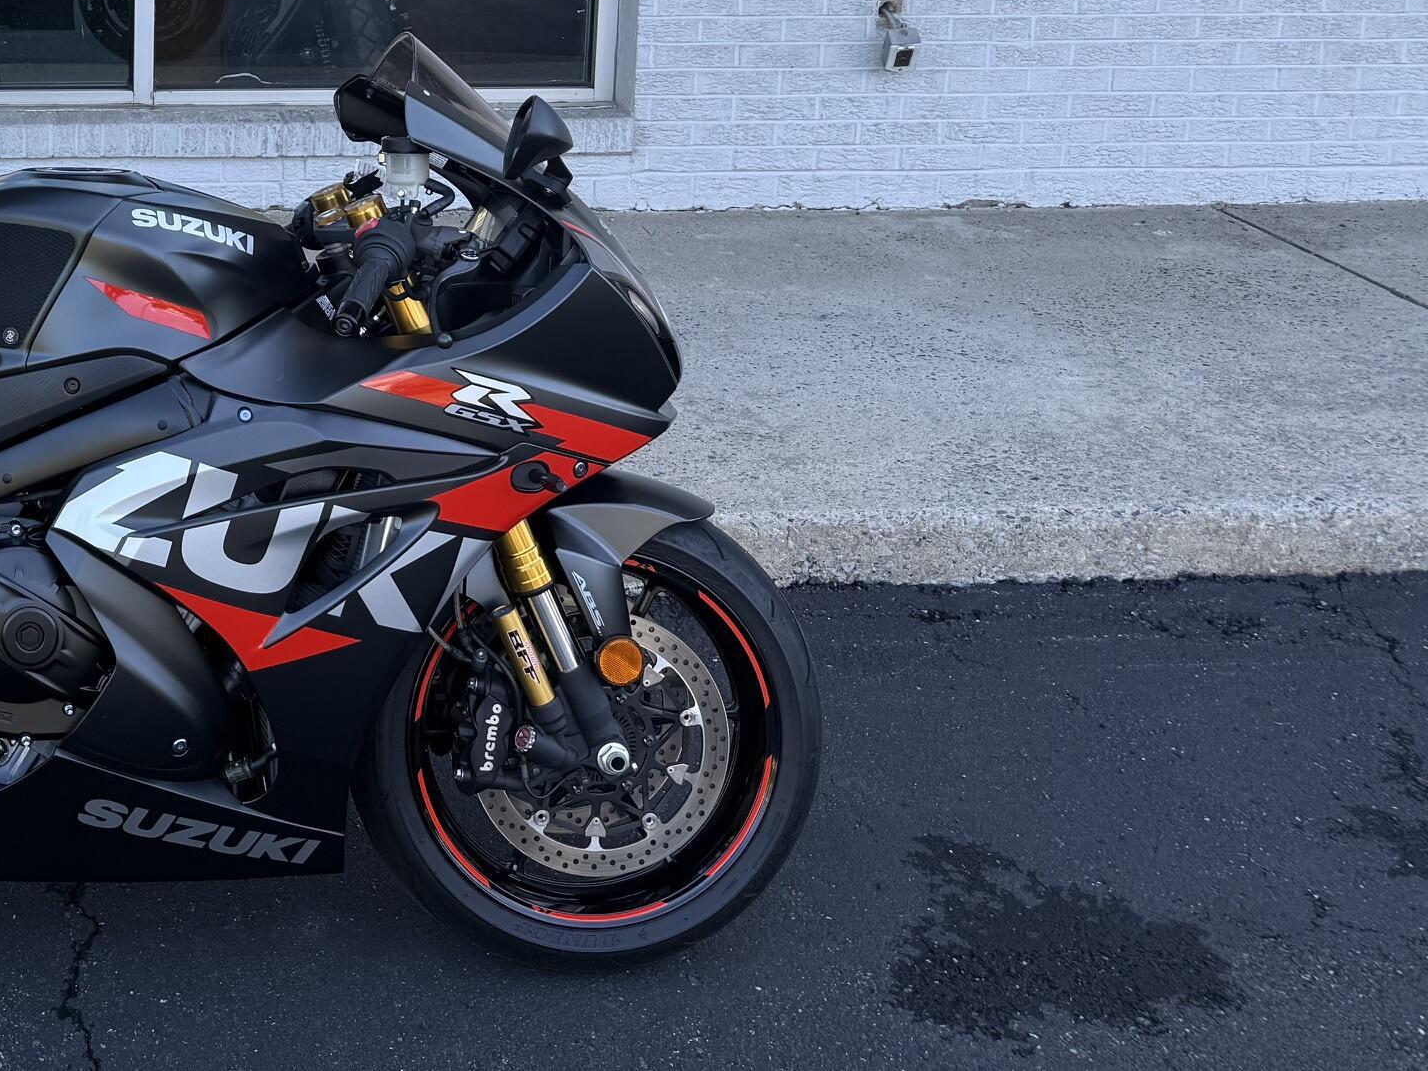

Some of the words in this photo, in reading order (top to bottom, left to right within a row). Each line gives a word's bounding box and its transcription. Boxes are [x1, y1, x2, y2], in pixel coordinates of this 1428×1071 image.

[131, 208, 255, 256] SUZUKI
[444, 403, 535, 434] GSX
[571, 570, 606, 628] ABS
[479, 703, 503, 772] brembo
[77, 798, 322, 865] SUZUKI
